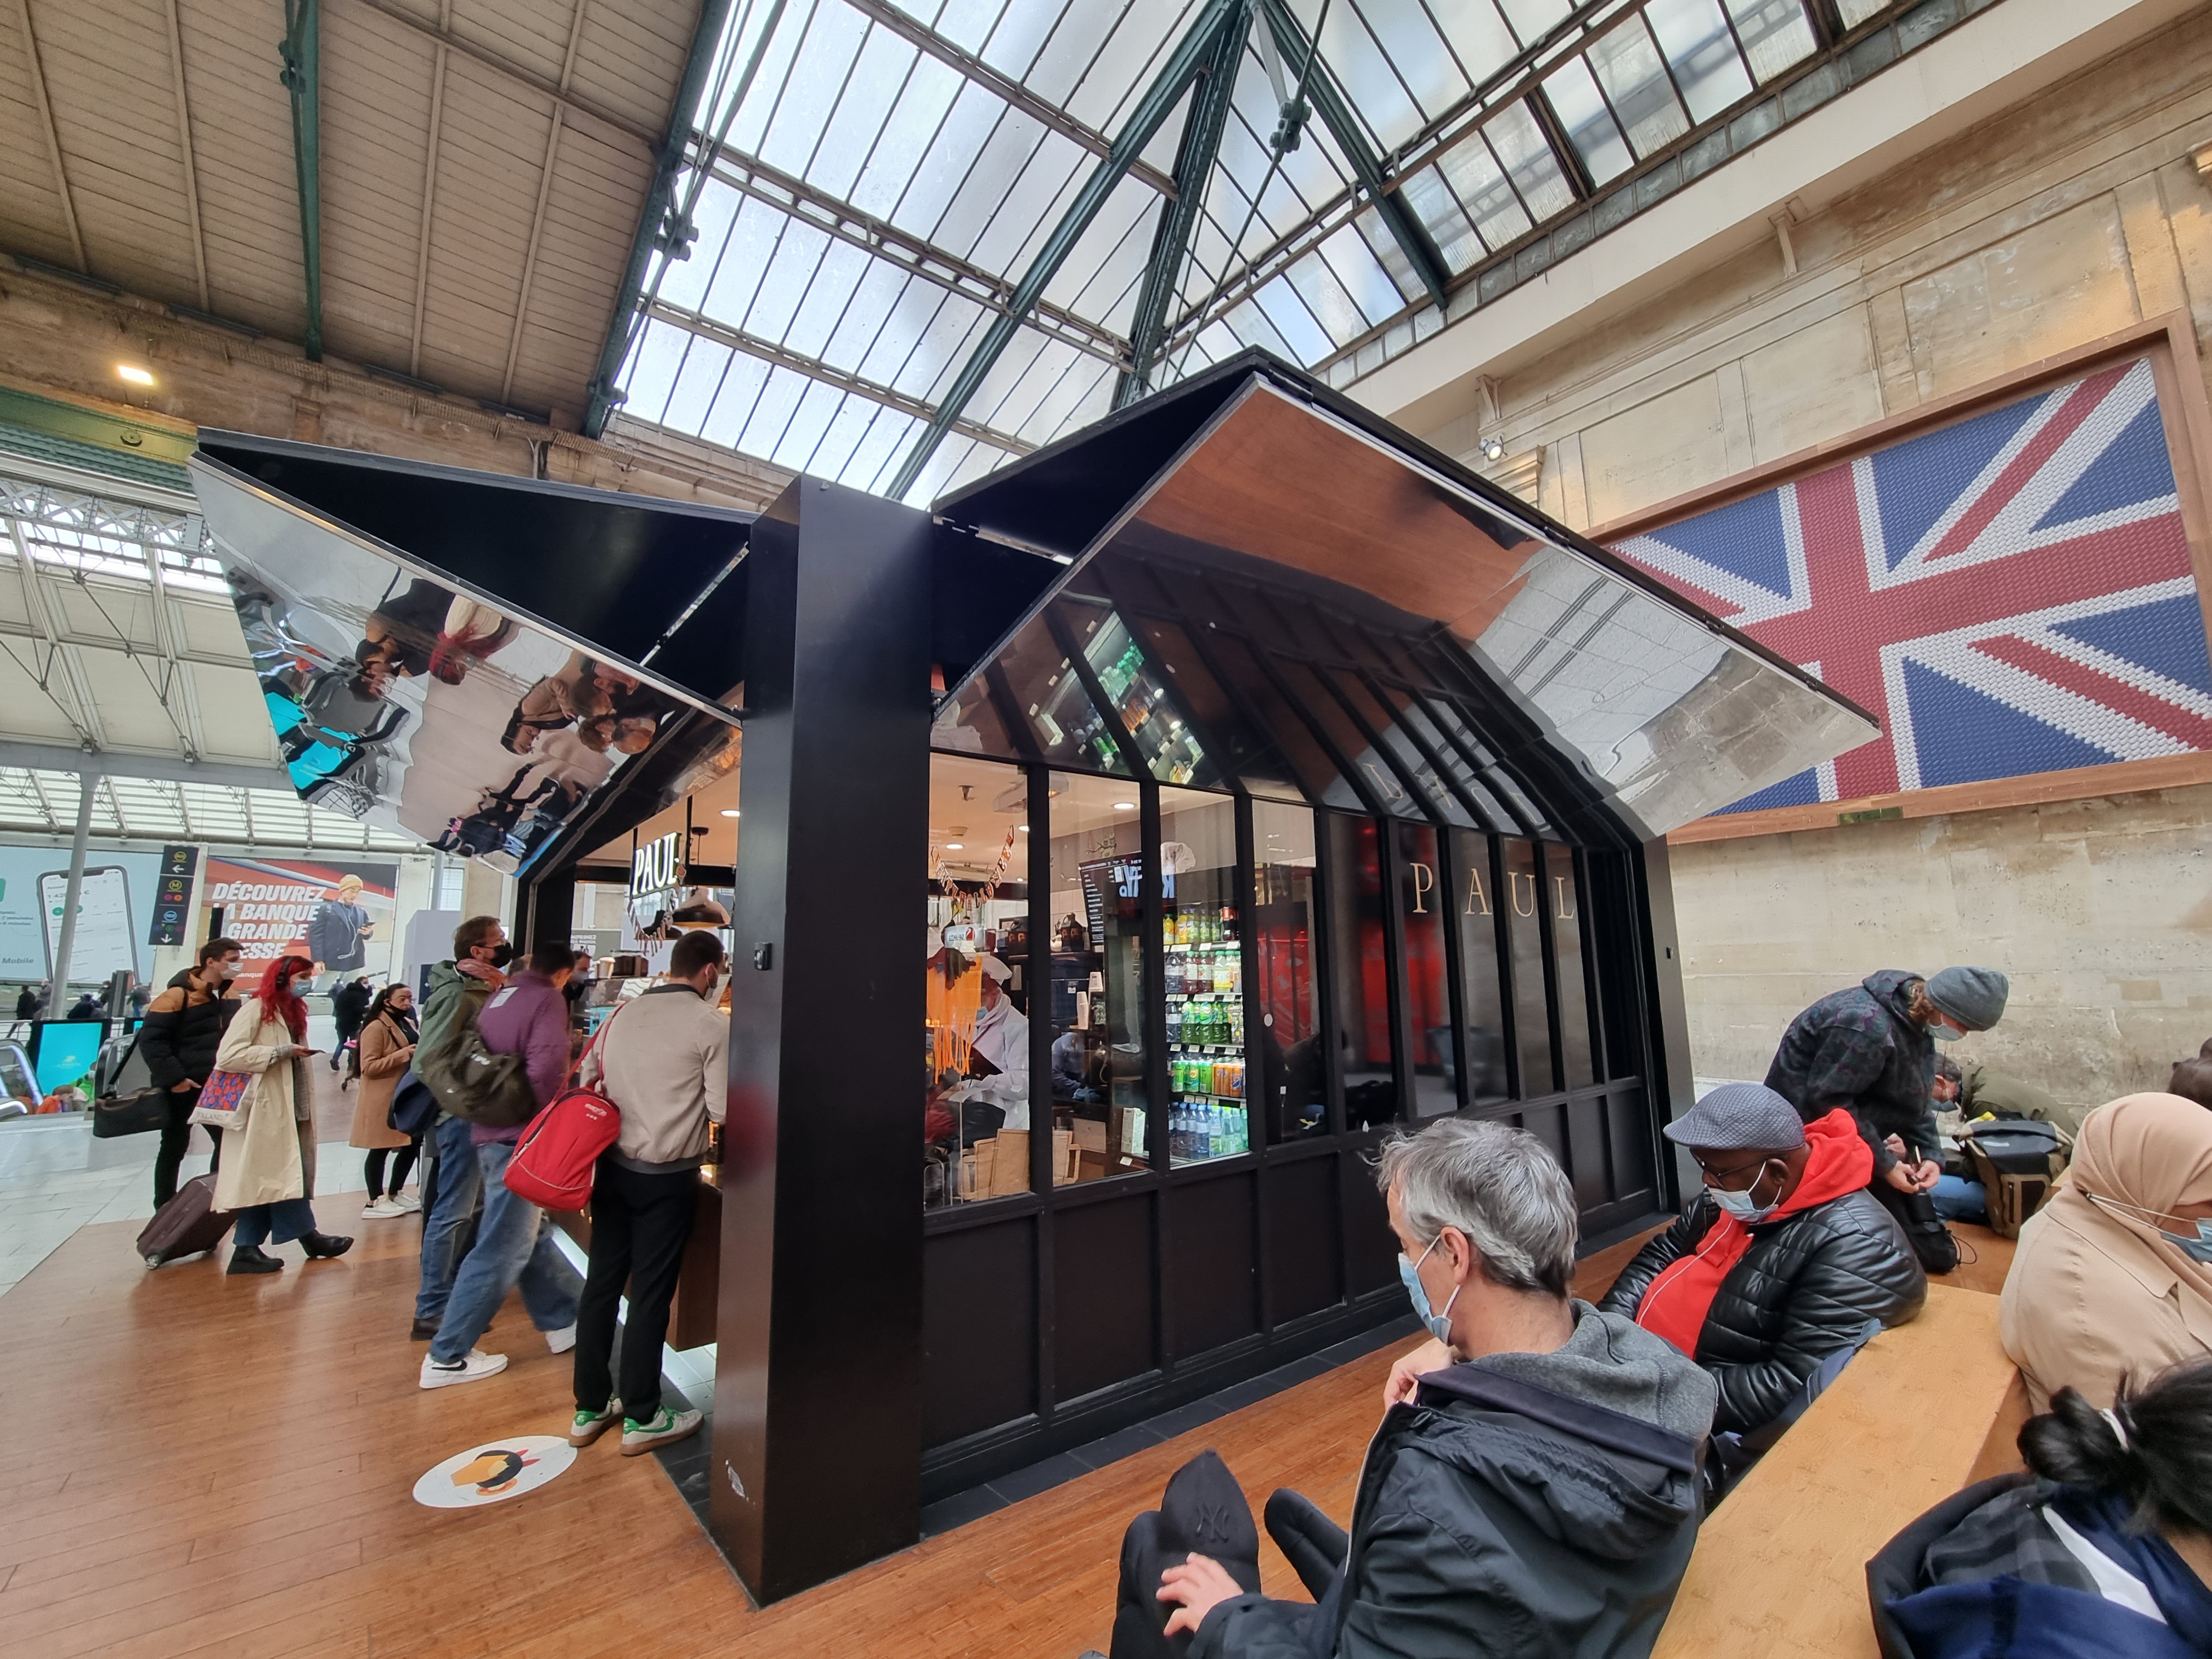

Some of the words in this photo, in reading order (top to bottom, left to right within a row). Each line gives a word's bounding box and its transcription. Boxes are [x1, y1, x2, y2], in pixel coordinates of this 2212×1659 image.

[631, 831, 679, 896] PAUL
[212, 881, 328, 902] DÉCOUVREZ
[1409, 862, 1575, 919] PAUL
[239, 904, 321, 923] BANQUE
[227, 922, 309, 940] GRANDE
[239, 942, 286, 960] ESSE
